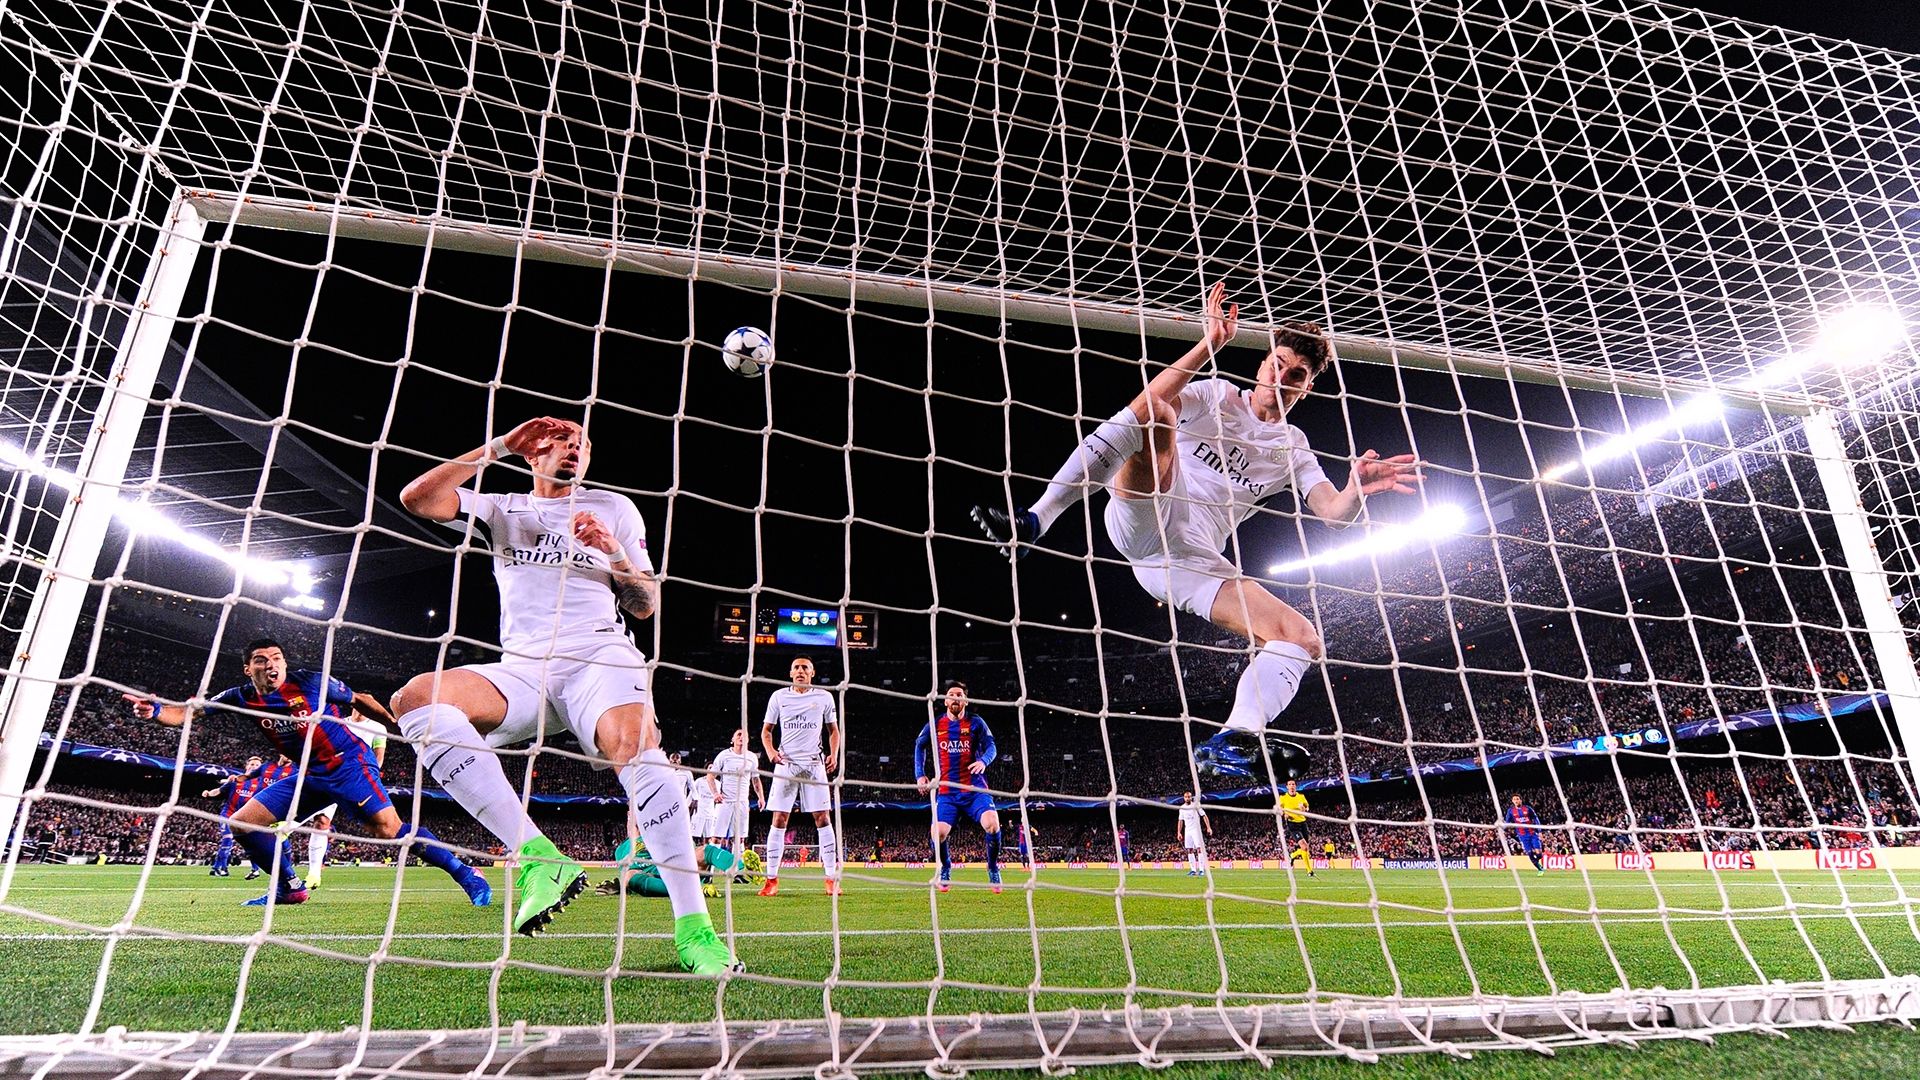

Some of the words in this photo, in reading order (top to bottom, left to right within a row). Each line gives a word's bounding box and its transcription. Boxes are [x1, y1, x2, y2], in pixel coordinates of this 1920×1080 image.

[1228, 446, 1250, 472] Fly
[534, 533, 562, 548] Fly
[783, 720, 818, 730] Emirates
[939, 740, 970, 750] QATAR
[441, 755, 476, 787] ARIS
[642, 801, 680, 831] PARIS
[1384, 860, 1401, 869] UEFA
[1401, 860, 1438, 869] CHAMPIONS
